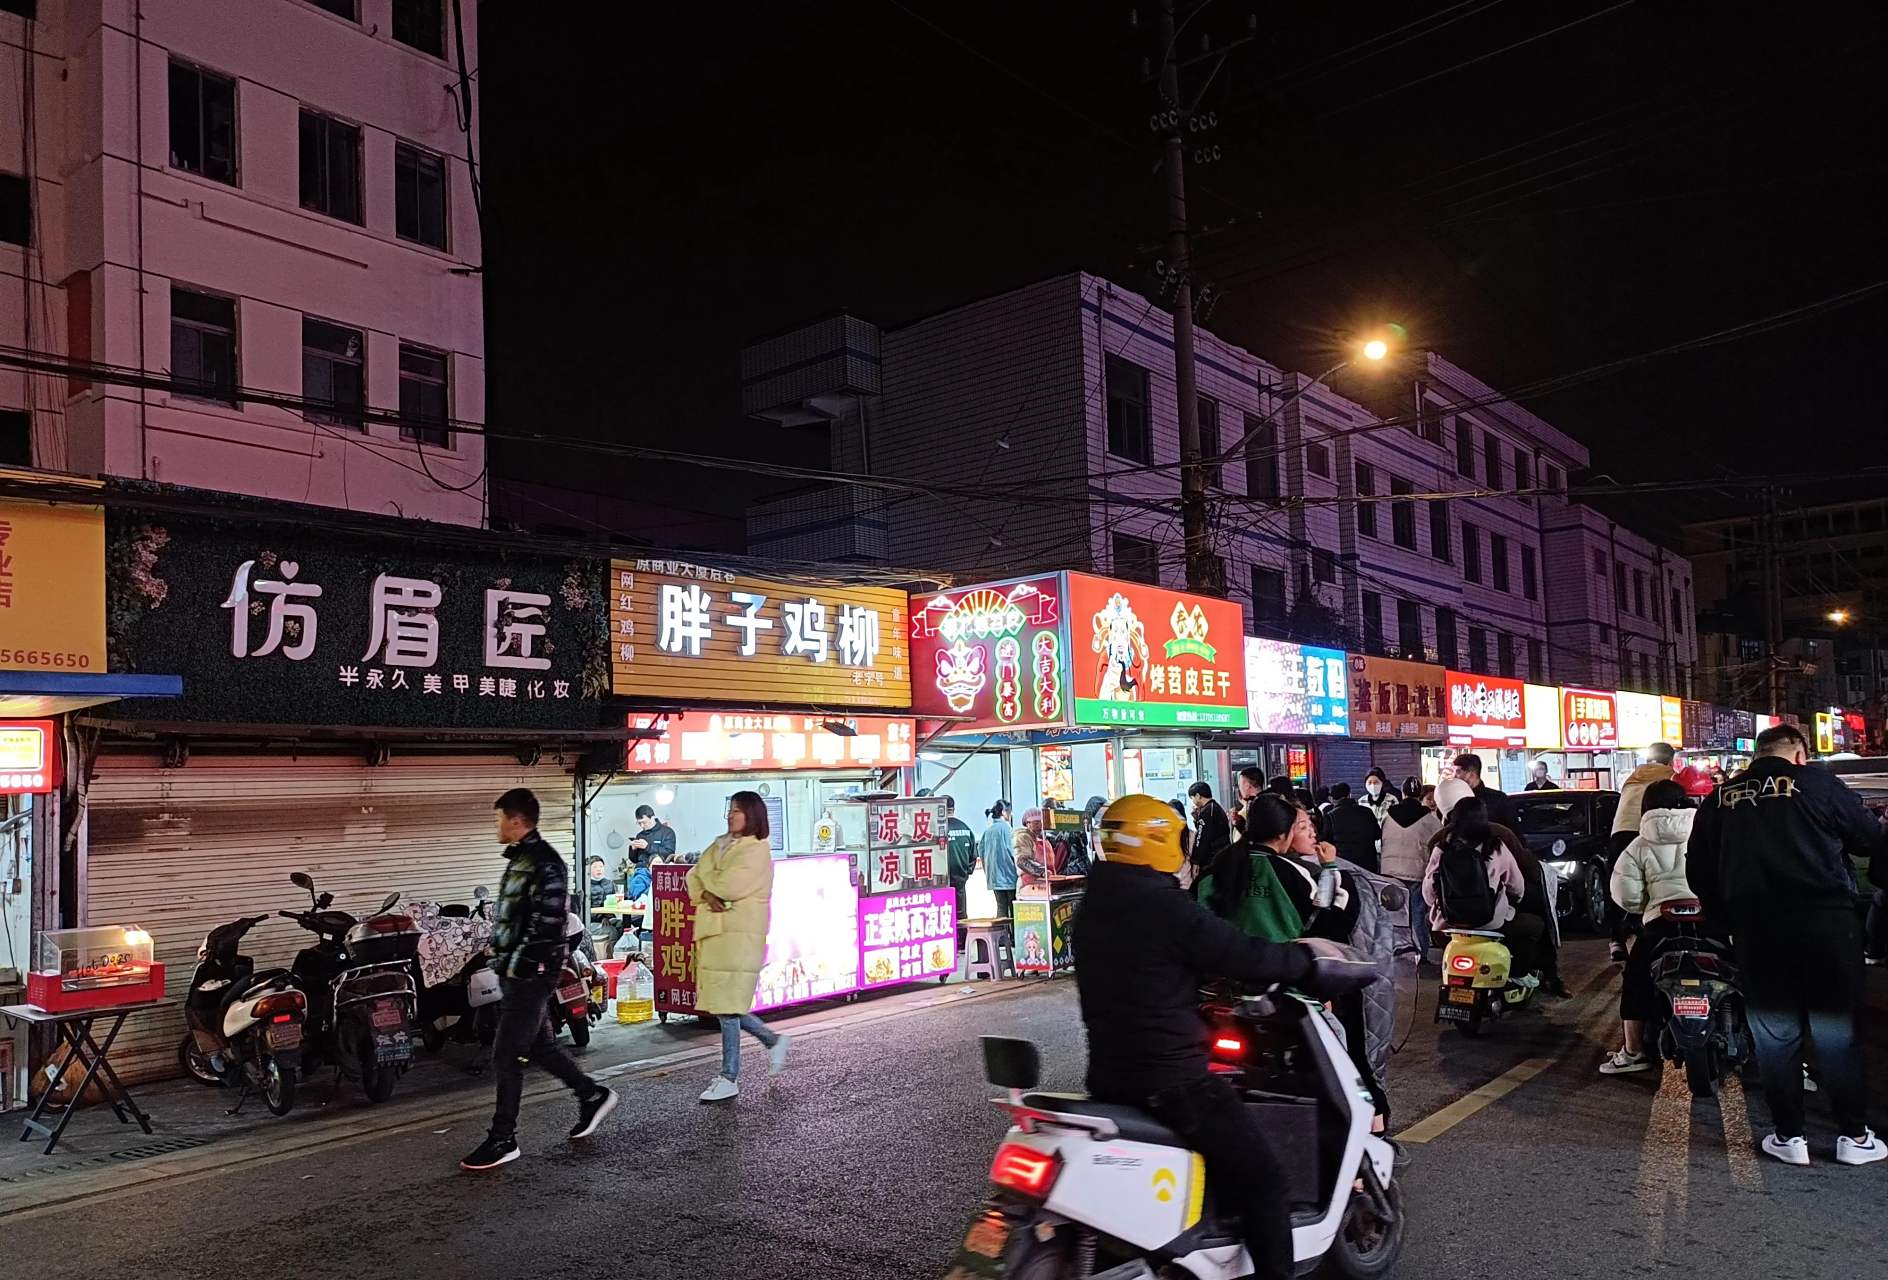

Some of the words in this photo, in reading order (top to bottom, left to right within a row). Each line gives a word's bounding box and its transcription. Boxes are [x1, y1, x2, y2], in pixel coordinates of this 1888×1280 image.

[221, 560, 552, 668] 仿眉匠
[620, 571, 635, 661] 网红鸡柳
[659, 584, 880, 666] 胖子鸡柳
[0, 650, 89, 668] 5665650
[1037, 635, 1056, 714] 大吉大利
[339, 666, 570, 699] 半永久美甲美睫化妆
[851, 670, 884, 686] 老字号
[1150, 664, 1231, 698] 烤苕皮豆干
[879, 808, 933, 842] 凉皮
[879, 848, 933, 885] 凉面
[864, 901, 954, 947] 正宗陕西凉皮
[671, 988, 697, 1006] 网红
